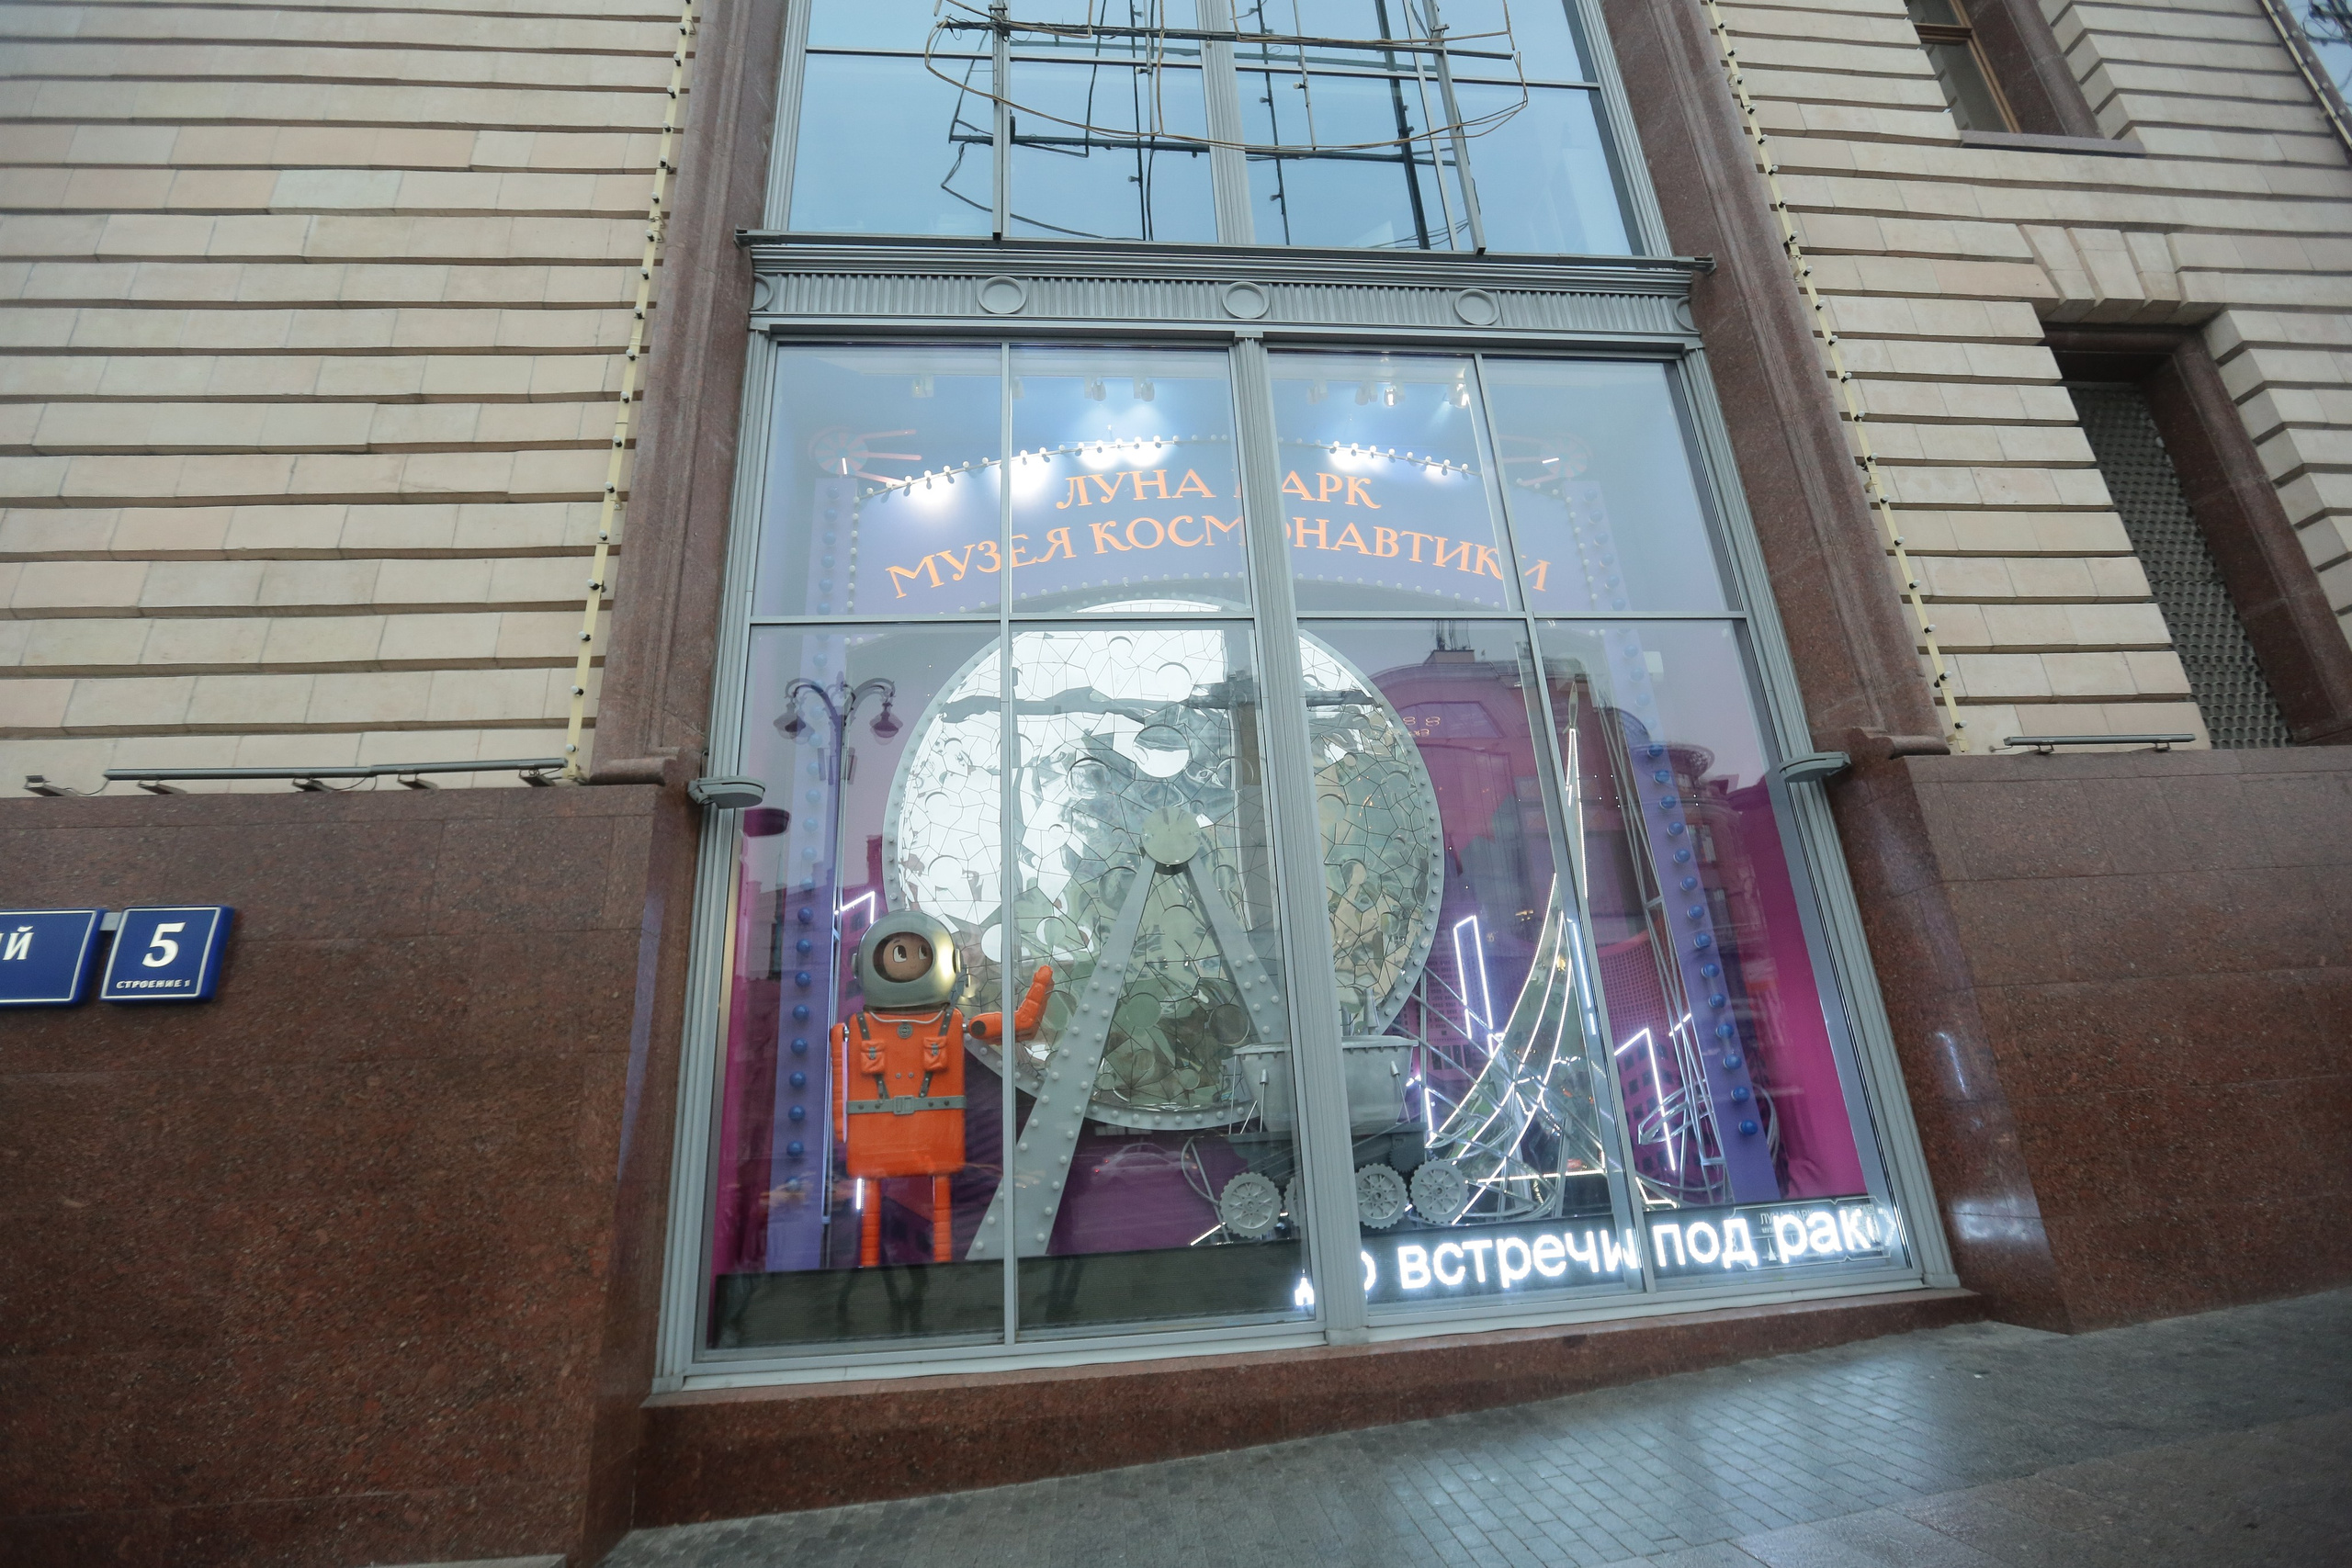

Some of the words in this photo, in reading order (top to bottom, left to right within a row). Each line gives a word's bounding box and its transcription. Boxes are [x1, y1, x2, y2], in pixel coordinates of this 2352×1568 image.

[1056, 468, 1216, 509] ЛУНА
[885, 526, 1077, 599] МУЗЕЯ
[1089, 514, 1552, 592] КОСМНАВТИКИ
[0, 925, 35, 961] Й
[141, 921, 187, 968] 5
[116, 979, 182, 989] СТРОЕНИЕ
[1396, 1228, 1638, 1289] встречи
[1653, 1217, 1758, 1269] под
[1773, 1205, 1895, 1264] рак
